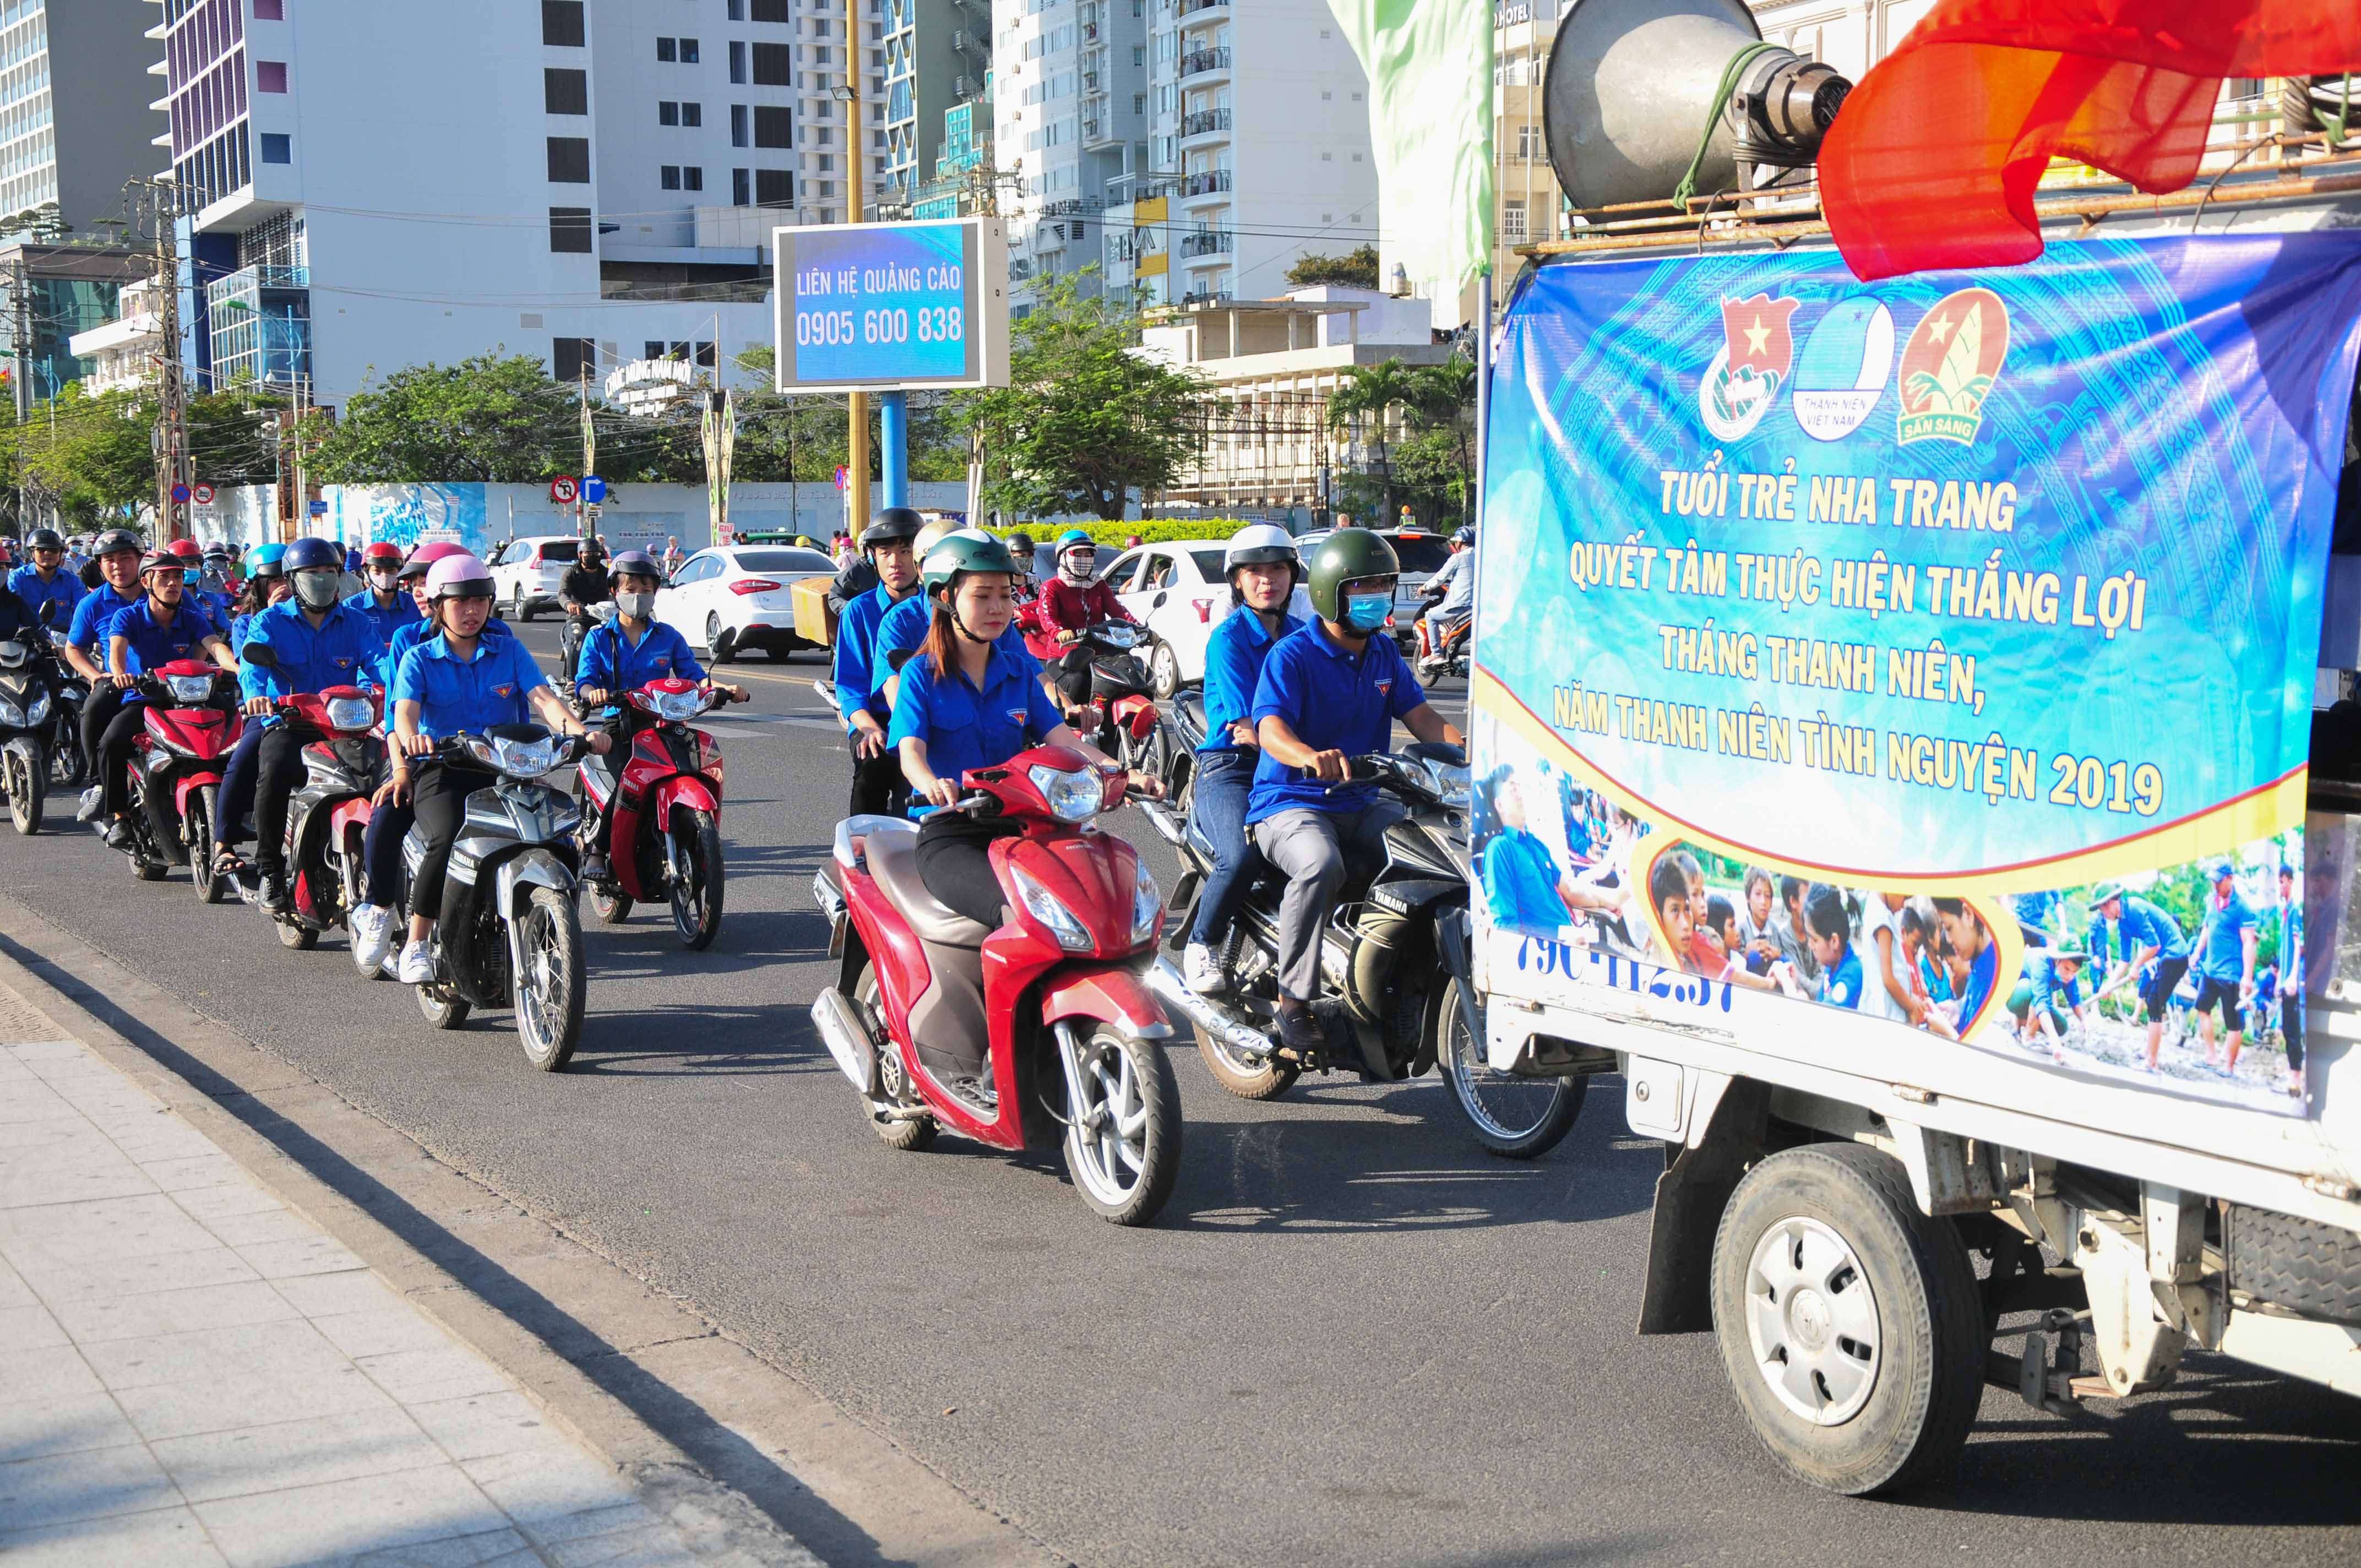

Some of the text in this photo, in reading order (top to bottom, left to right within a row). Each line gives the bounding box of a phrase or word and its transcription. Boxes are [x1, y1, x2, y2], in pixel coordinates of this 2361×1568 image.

[1499, 3, 1528, 26] HOTEL
[797, 262, 961, 298] LIÊN HỆ QUẢNG CÁO
[797, 307, 962, 346] 0905 600 838
[1804, 398, 1838, 410] THANH
[1832, 415, 1856, 426] NAM
[1660, 449, 2019, 533] TUỔI TRẺ NHA TRANG
[1569, 530, 2147, 640] QUYẾT TÂM THỰC HIỆN THẮNG LỢI
[1658, 617, 1985, 716] THÁNG THANH NIÊN,
[1553, 679, 2164, 817] NĂM THANH NIÊN TÌNH NGUYỆN 2019
[454, 849, 475, 869] YAMAHA
[1374, 889, 1408, 915] YAMAHA
[984, 948, 1008, 965] HONDA
